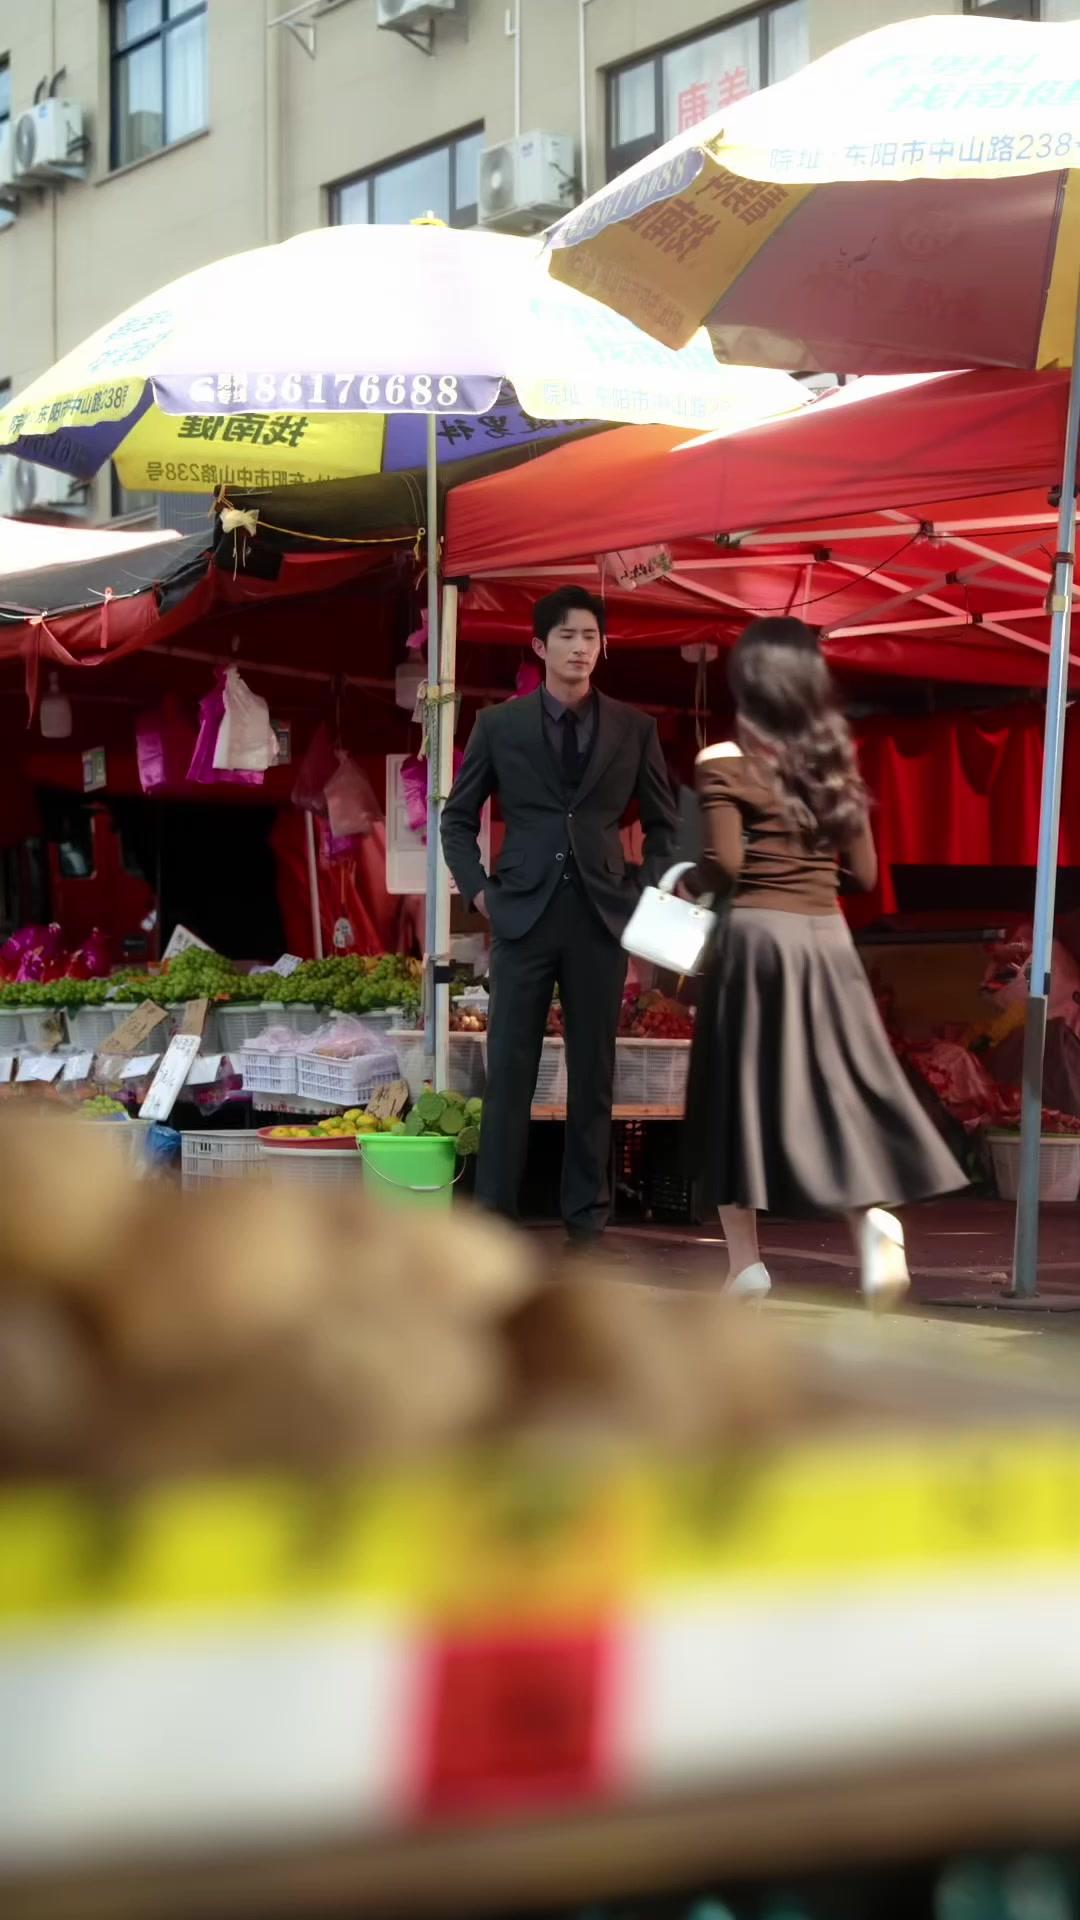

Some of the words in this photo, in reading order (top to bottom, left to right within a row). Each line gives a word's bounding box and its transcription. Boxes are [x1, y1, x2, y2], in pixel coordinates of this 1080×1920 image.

[843, 132, 1080, 168] 东阳市中山路238
[255, 372, 459, 406] 86176688
